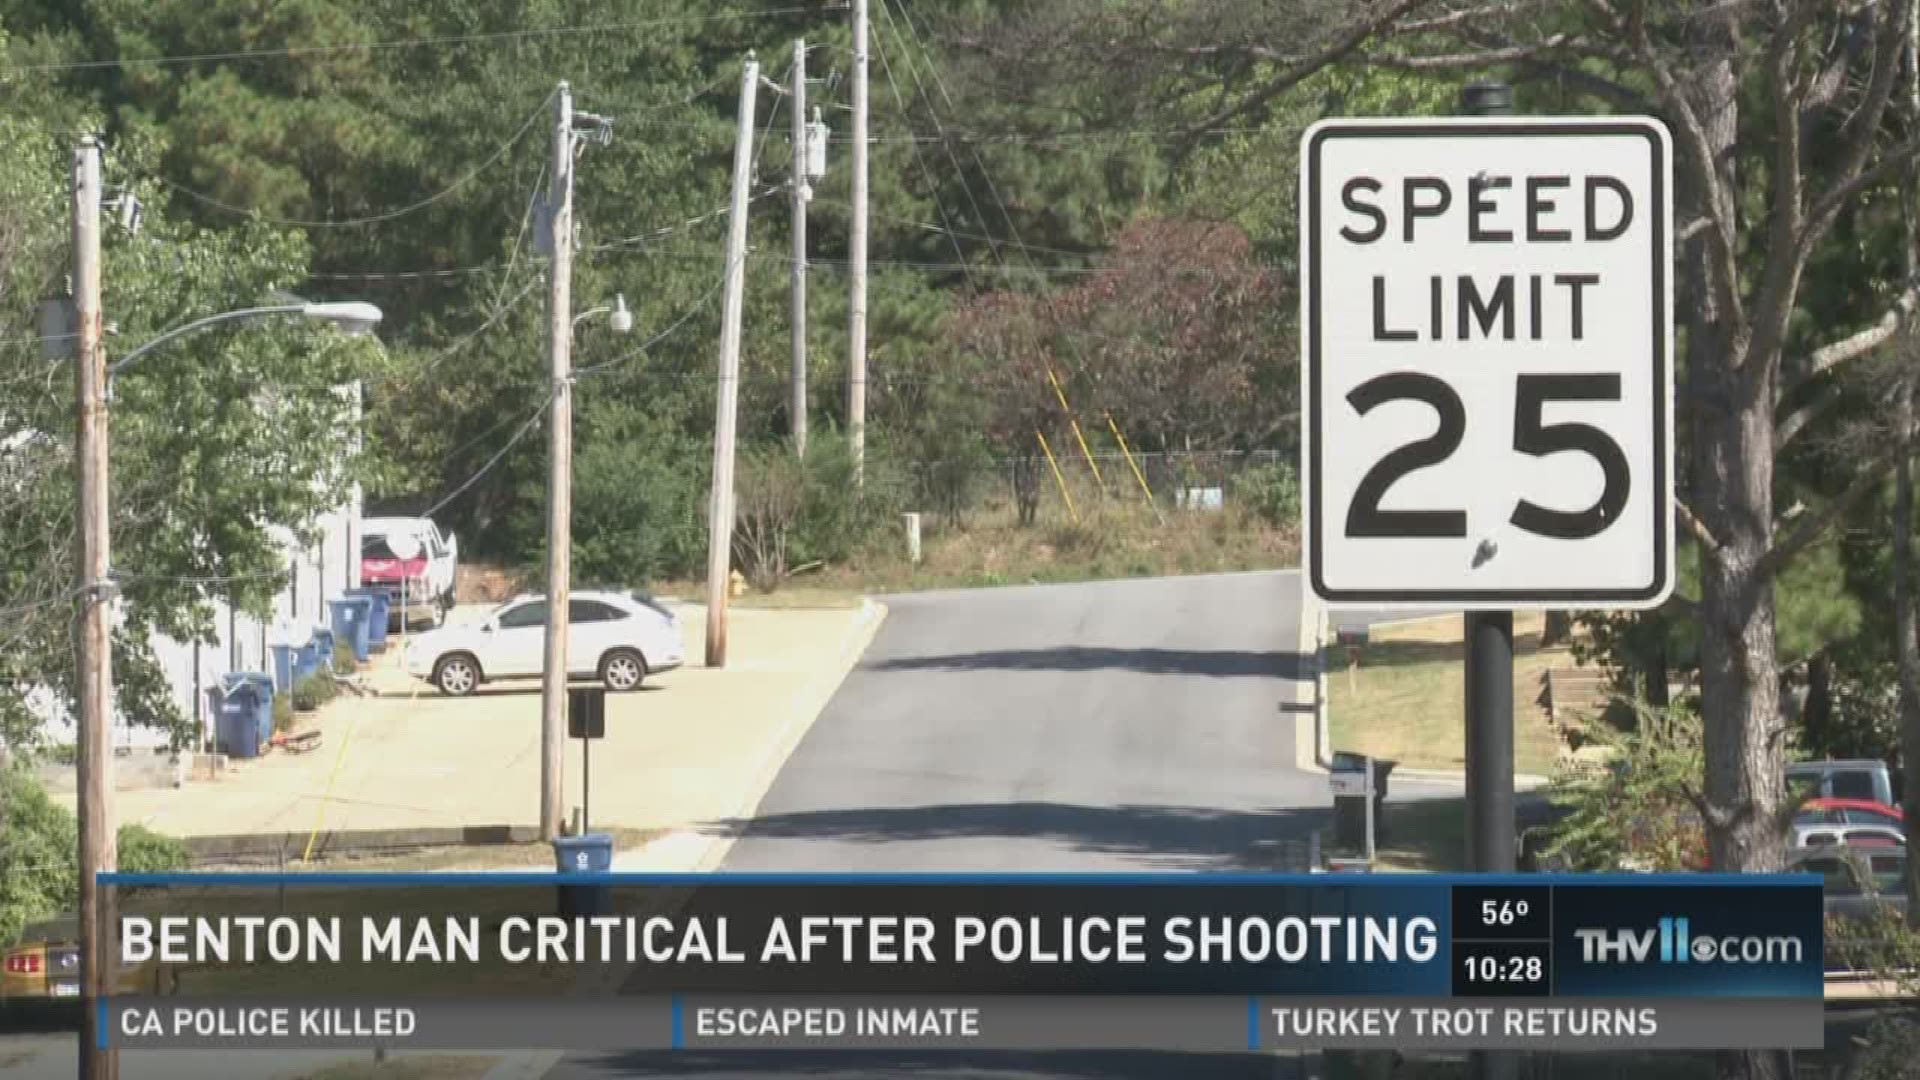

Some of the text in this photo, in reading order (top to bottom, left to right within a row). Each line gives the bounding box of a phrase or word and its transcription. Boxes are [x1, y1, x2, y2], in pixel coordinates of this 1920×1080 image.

[1339, 175, 1635, 244] SPEED
[1372, 274, 1600, 341] LIMIT
[1344, 371, 1632, 540] 25
